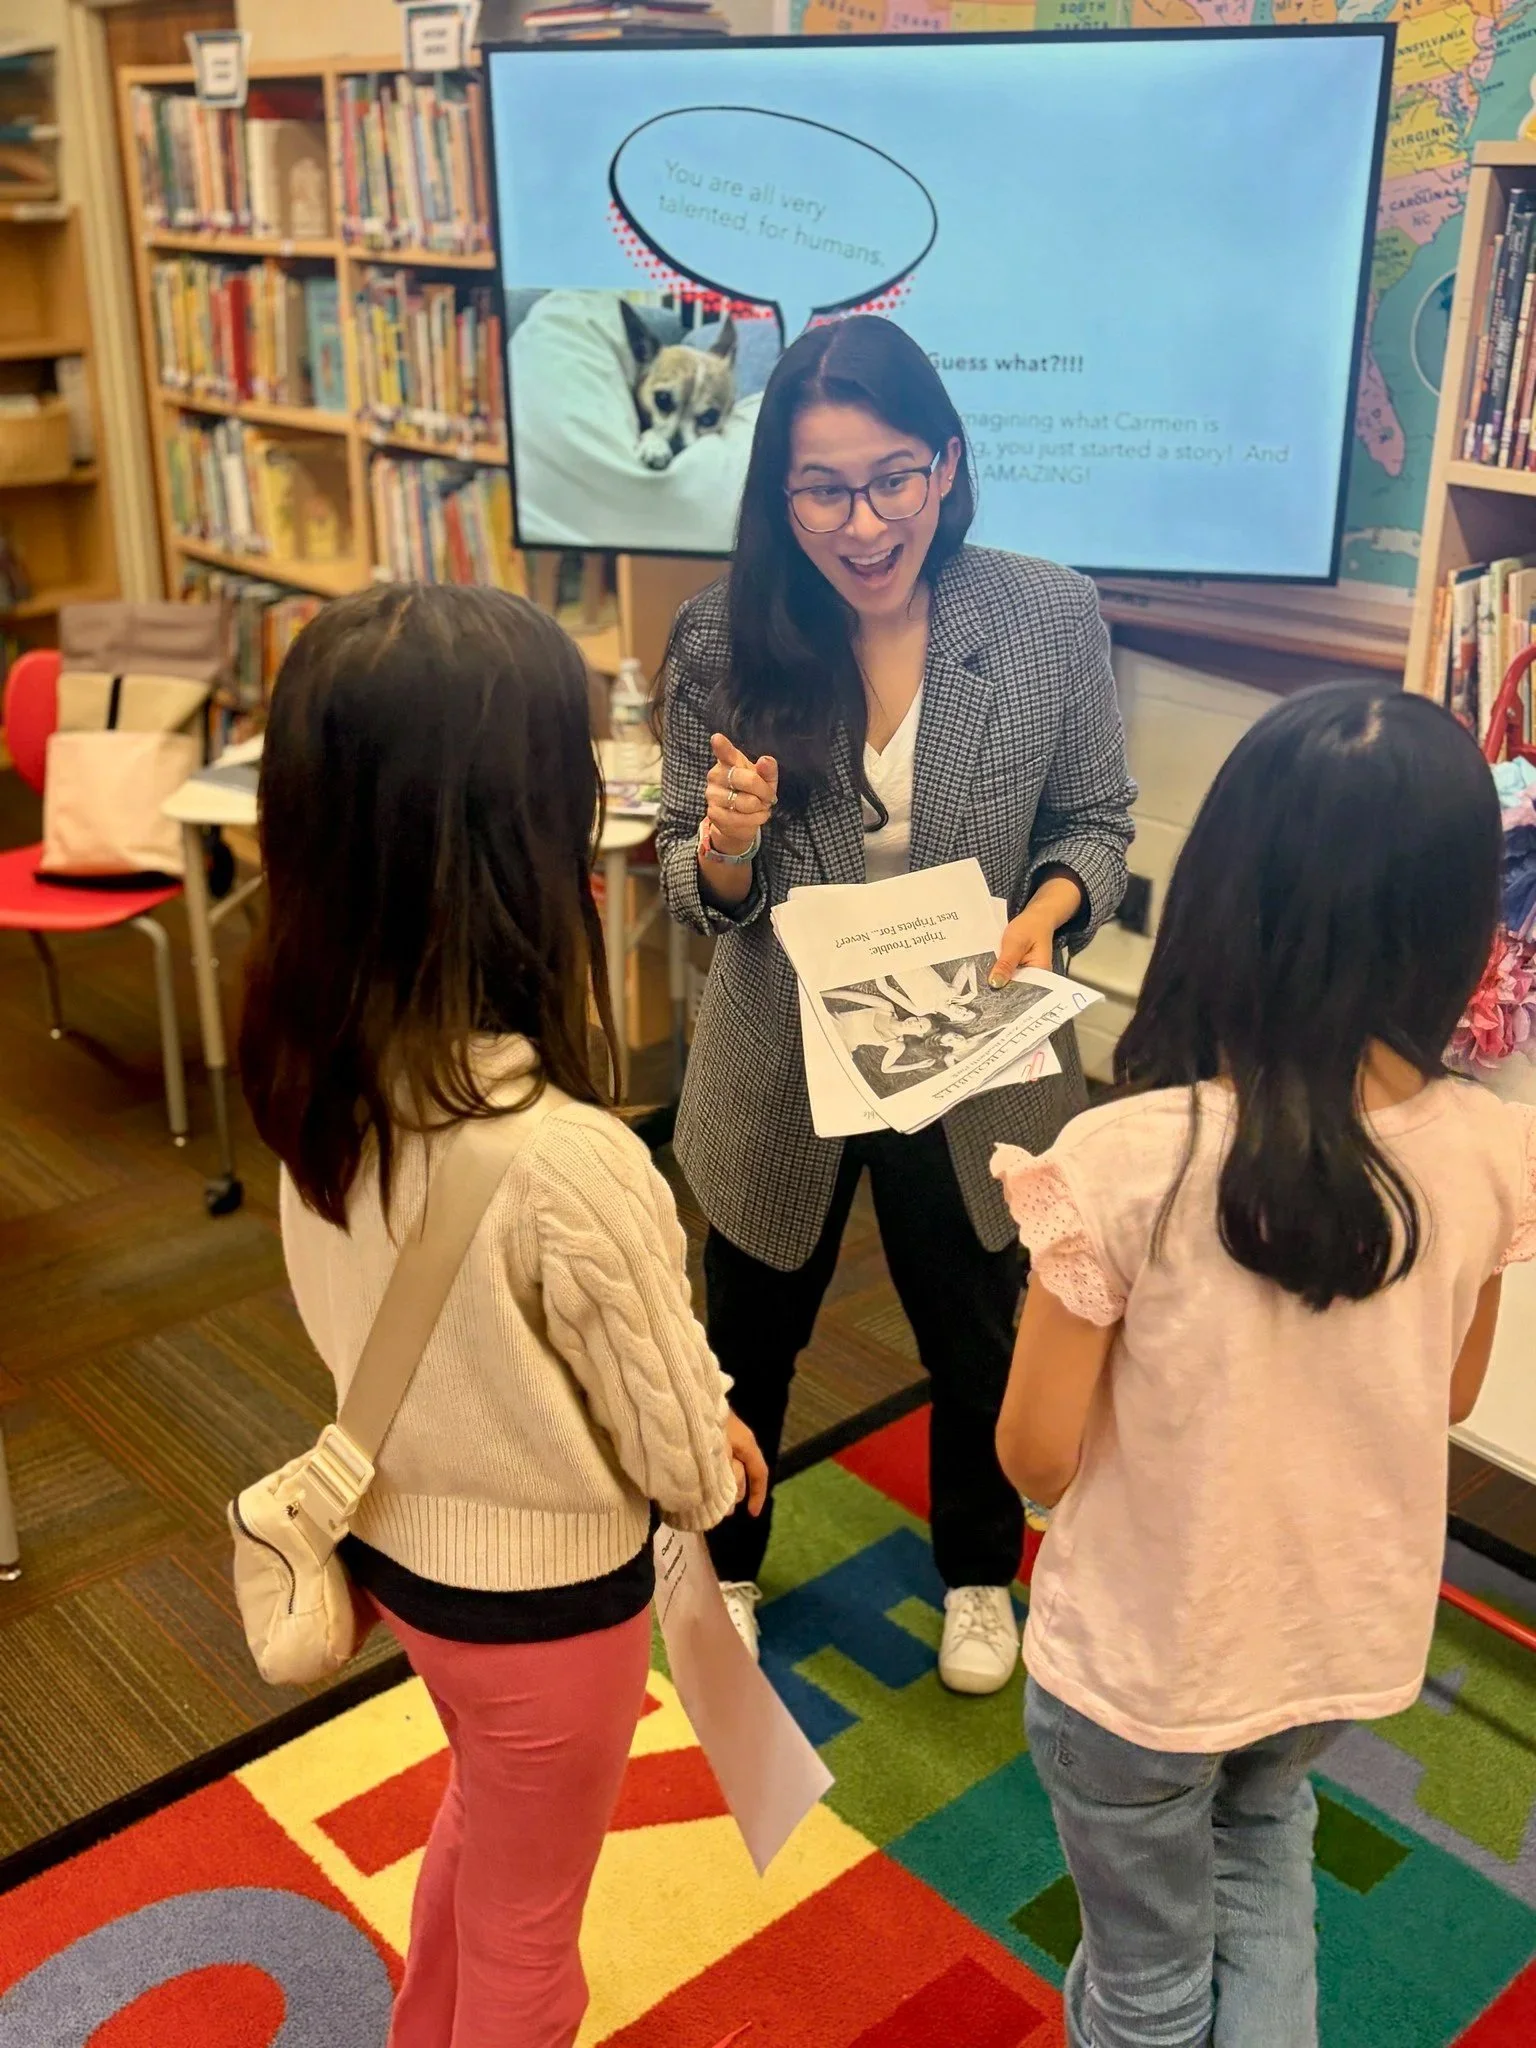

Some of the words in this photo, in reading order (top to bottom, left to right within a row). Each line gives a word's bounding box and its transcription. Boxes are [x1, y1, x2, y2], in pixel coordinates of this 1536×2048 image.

[1397, 28, 1467, 56] NNSYLVANIA
[1392, 122, 1456, 148] VIRGINIA
[665, 159, 703, 188] You
[709, 177, 743, 197] are
[750, 182, 775, 204] all
[781, 192, 827, 222] very
[659, 194, 750, 235] talented,
[759, 214, 789, 240] for
[793, 224, 885, 268] humans.
[928, 352, 987, 371] Guess
[995, 353, 1084, 373] what?!!!
[959, 413, 1053, 433] magining
[1060, 410, 1108, 430] what
[1114, 411, 1199, 433] Carmen
[1203, 415, 1219, 433] is
[996, 442, 1034, 460] you
[1038, 439, 1075, 460] just
[1080, 440, 1152, 460] started
[1156, 447, 1169, 460] a
[1175, 444, 1233, 467] story!
[1244, 444, 1290, 464] And
[983, 464, 1091, 485] AMAZING!
[897, 917, 937, 932] Triplets
[936, 911, 960, 923] Best
[835, 932, 871, 949] Never?
[868, 939, 913, 956] Trouble:
[912, 931, 947, 946] Triplet
